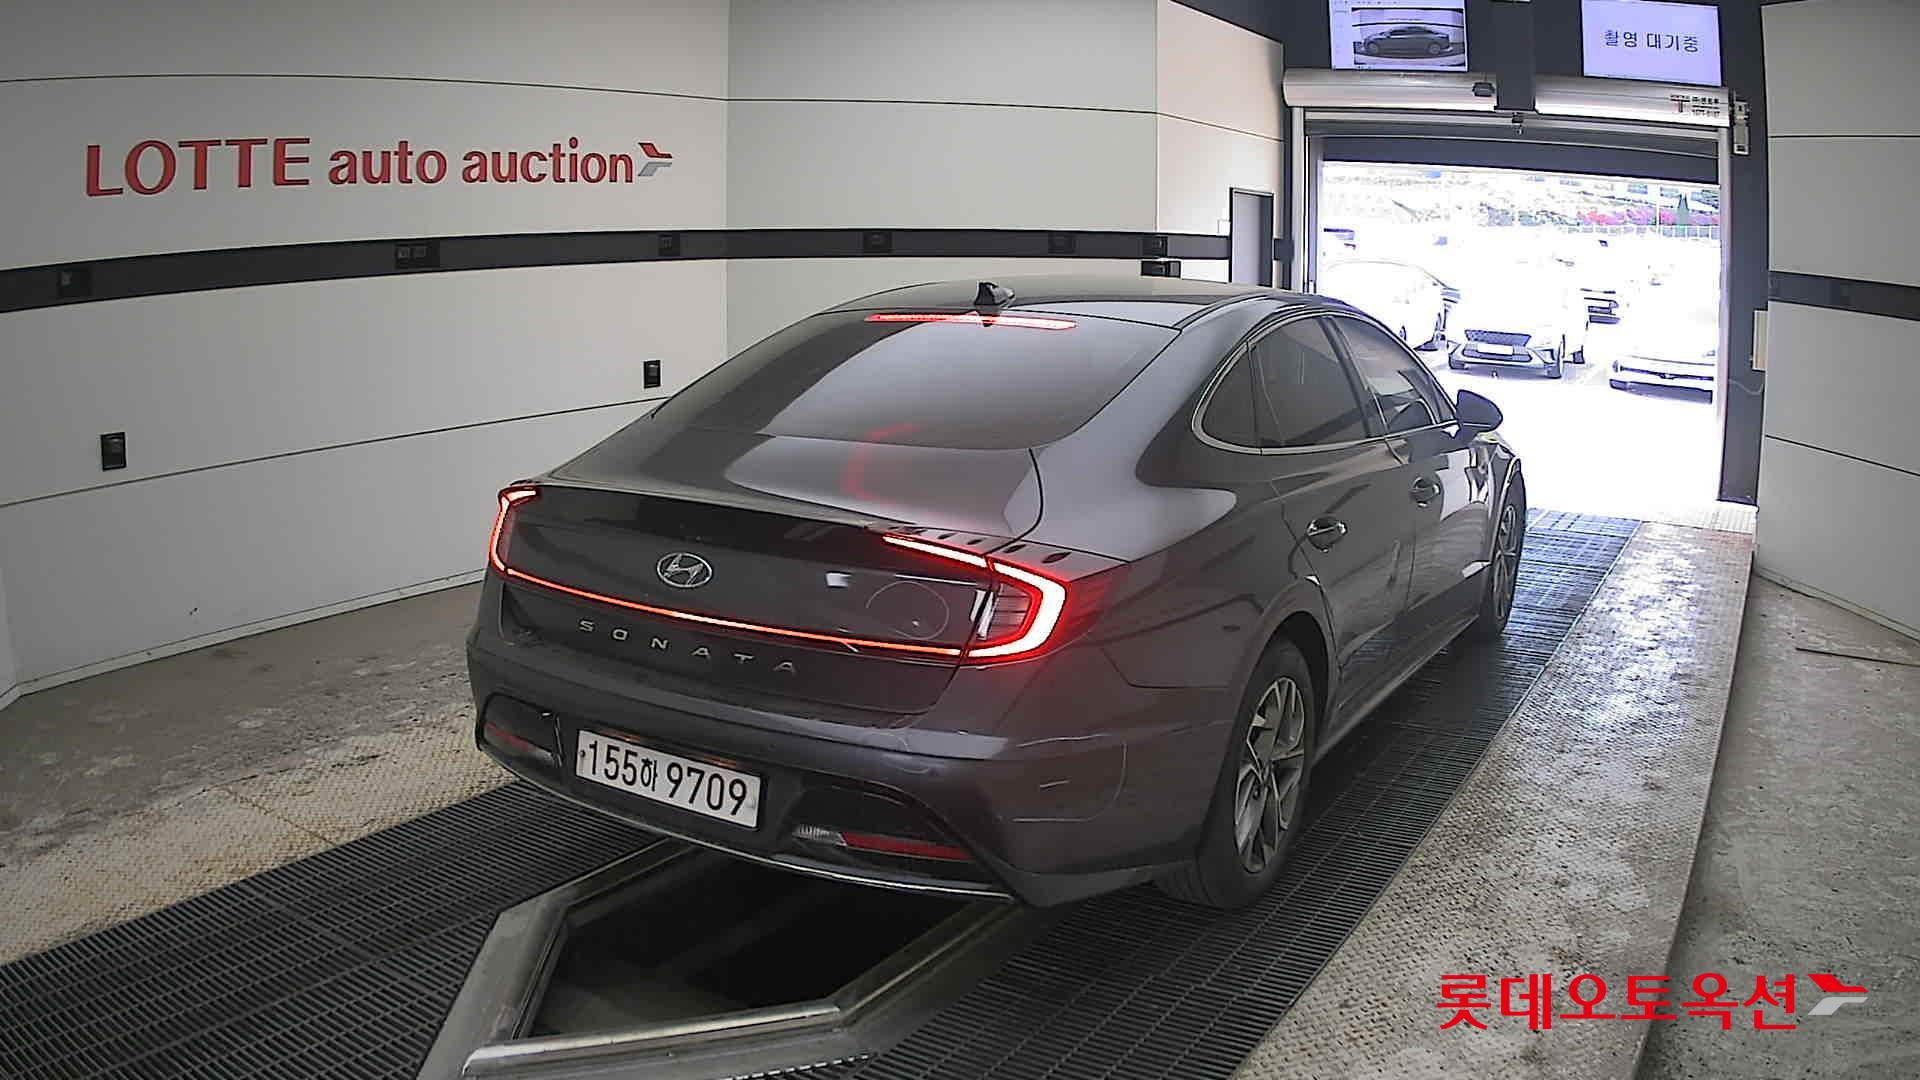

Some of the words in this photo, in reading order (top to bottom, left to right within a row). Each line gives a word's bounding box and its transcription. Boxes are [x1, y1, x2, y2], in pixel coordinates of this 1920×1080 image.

[1604, 30, 1637, 48] 촬영
[1646, 33, 1698, 52] 대기중
[86, 137, 310, 197] LOTTE
[328, 140, 448, 186] auto
[461, 136, 634, 184] auction
[579, 619, 796, 676] SONATA
[589, 740, 658, 792] 155하
[667, 762, 747, 815] 9709
